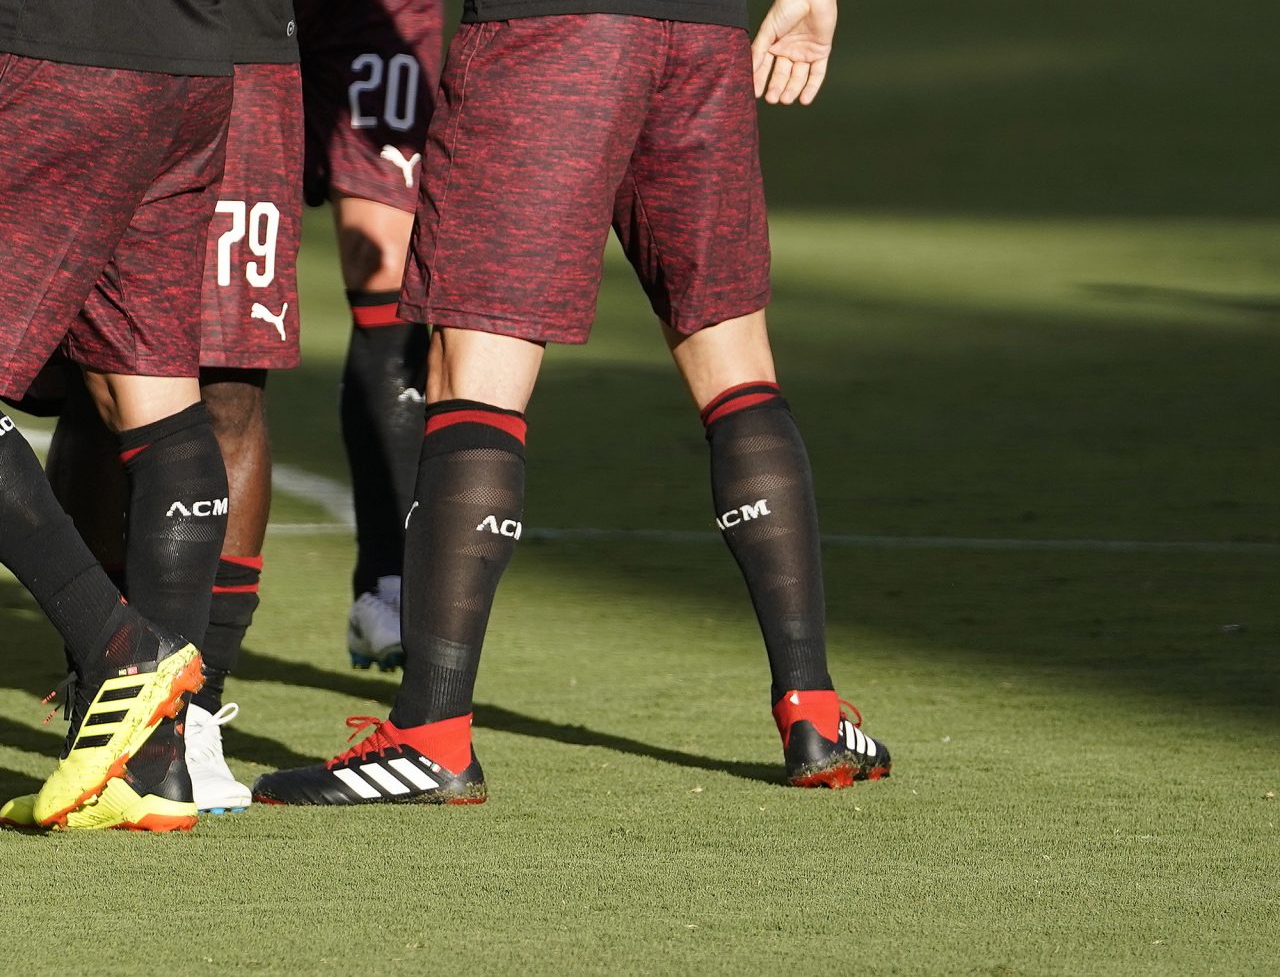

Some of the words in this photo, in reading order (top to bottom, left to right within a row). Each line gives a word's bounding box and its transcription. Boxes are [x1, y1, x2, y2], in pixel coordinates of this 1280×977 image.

[348, 53, 420, 132] 20
[214, 200, 280, 288] 79
[165, 497, 229, 517] ACM
